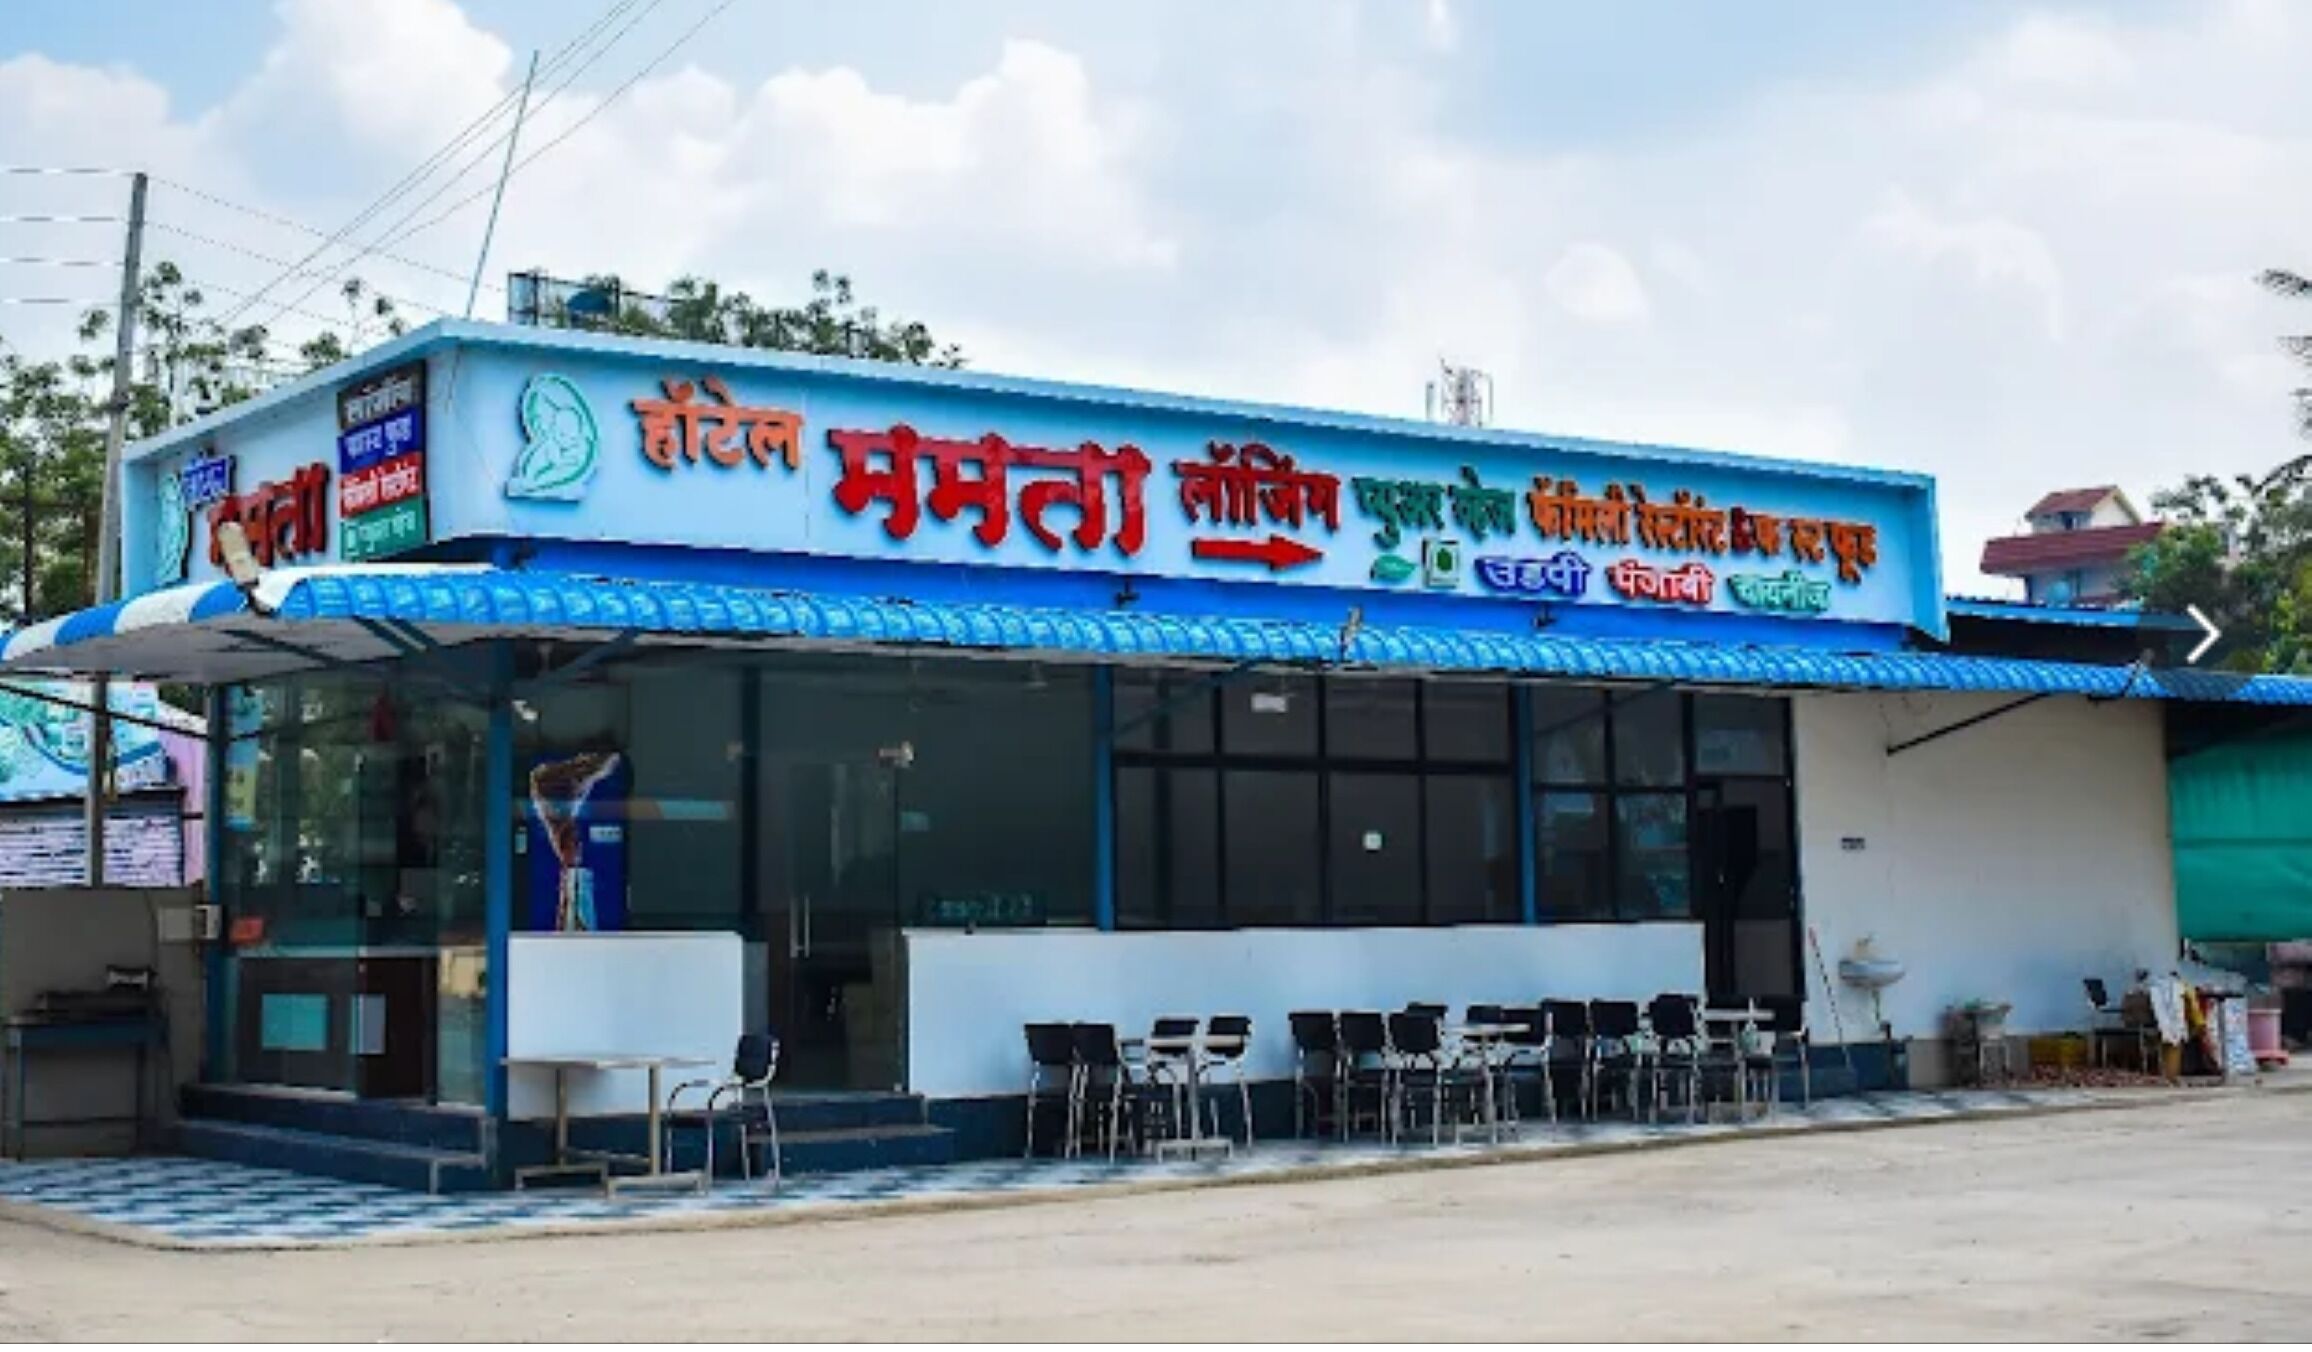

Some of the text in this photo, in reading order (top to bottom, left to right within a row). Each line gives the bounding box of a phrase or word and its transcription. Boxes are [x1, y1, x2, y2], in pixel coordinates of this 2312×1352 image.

[631, 375, 803, 471] हॉटेल
[829, 422, 1151, 557] ममता
[1171, 441, 1342, 531] लॉजिंग
[1606, 558, 1717, 604] पंजाबी
